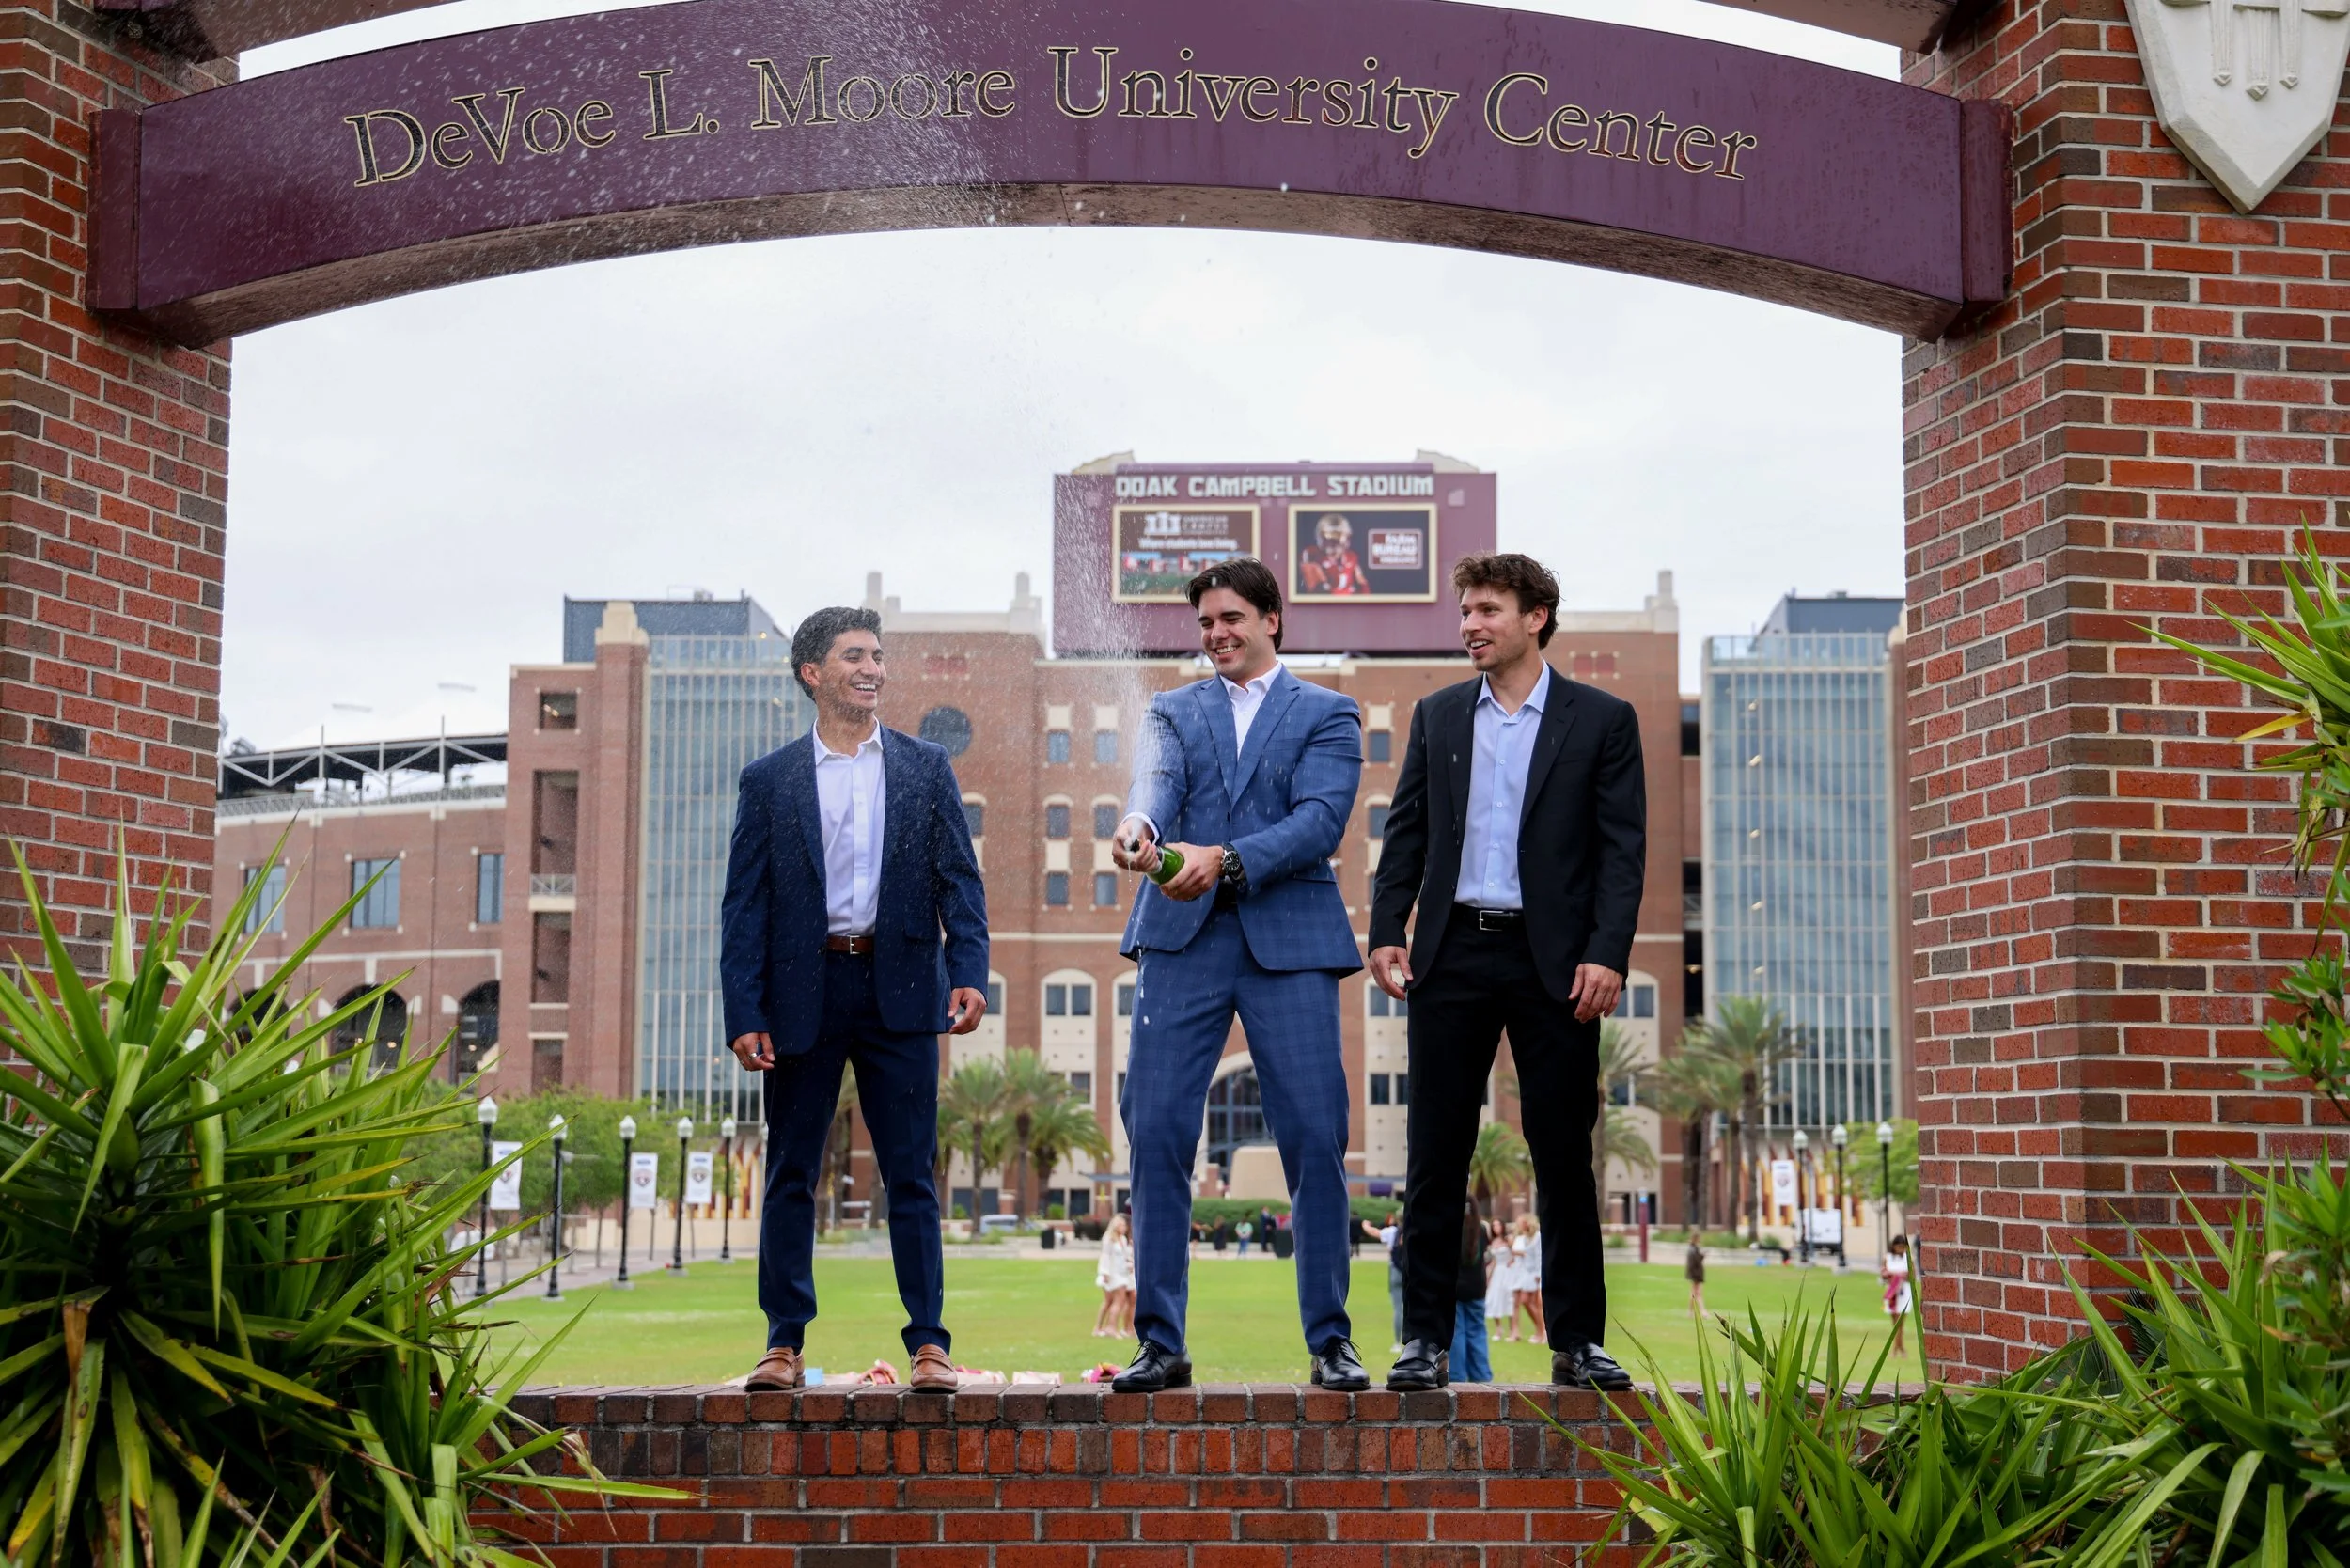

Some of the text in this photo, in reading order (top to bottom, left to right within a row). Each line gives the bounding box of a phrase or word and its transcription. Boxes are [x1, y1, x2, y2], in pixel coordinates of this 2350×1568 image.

[344, 45, 1757, 188] DeVoe L. Moore University Center
[1115, 475, 1434, 497] DOAK CAMPBELL STADIUM
